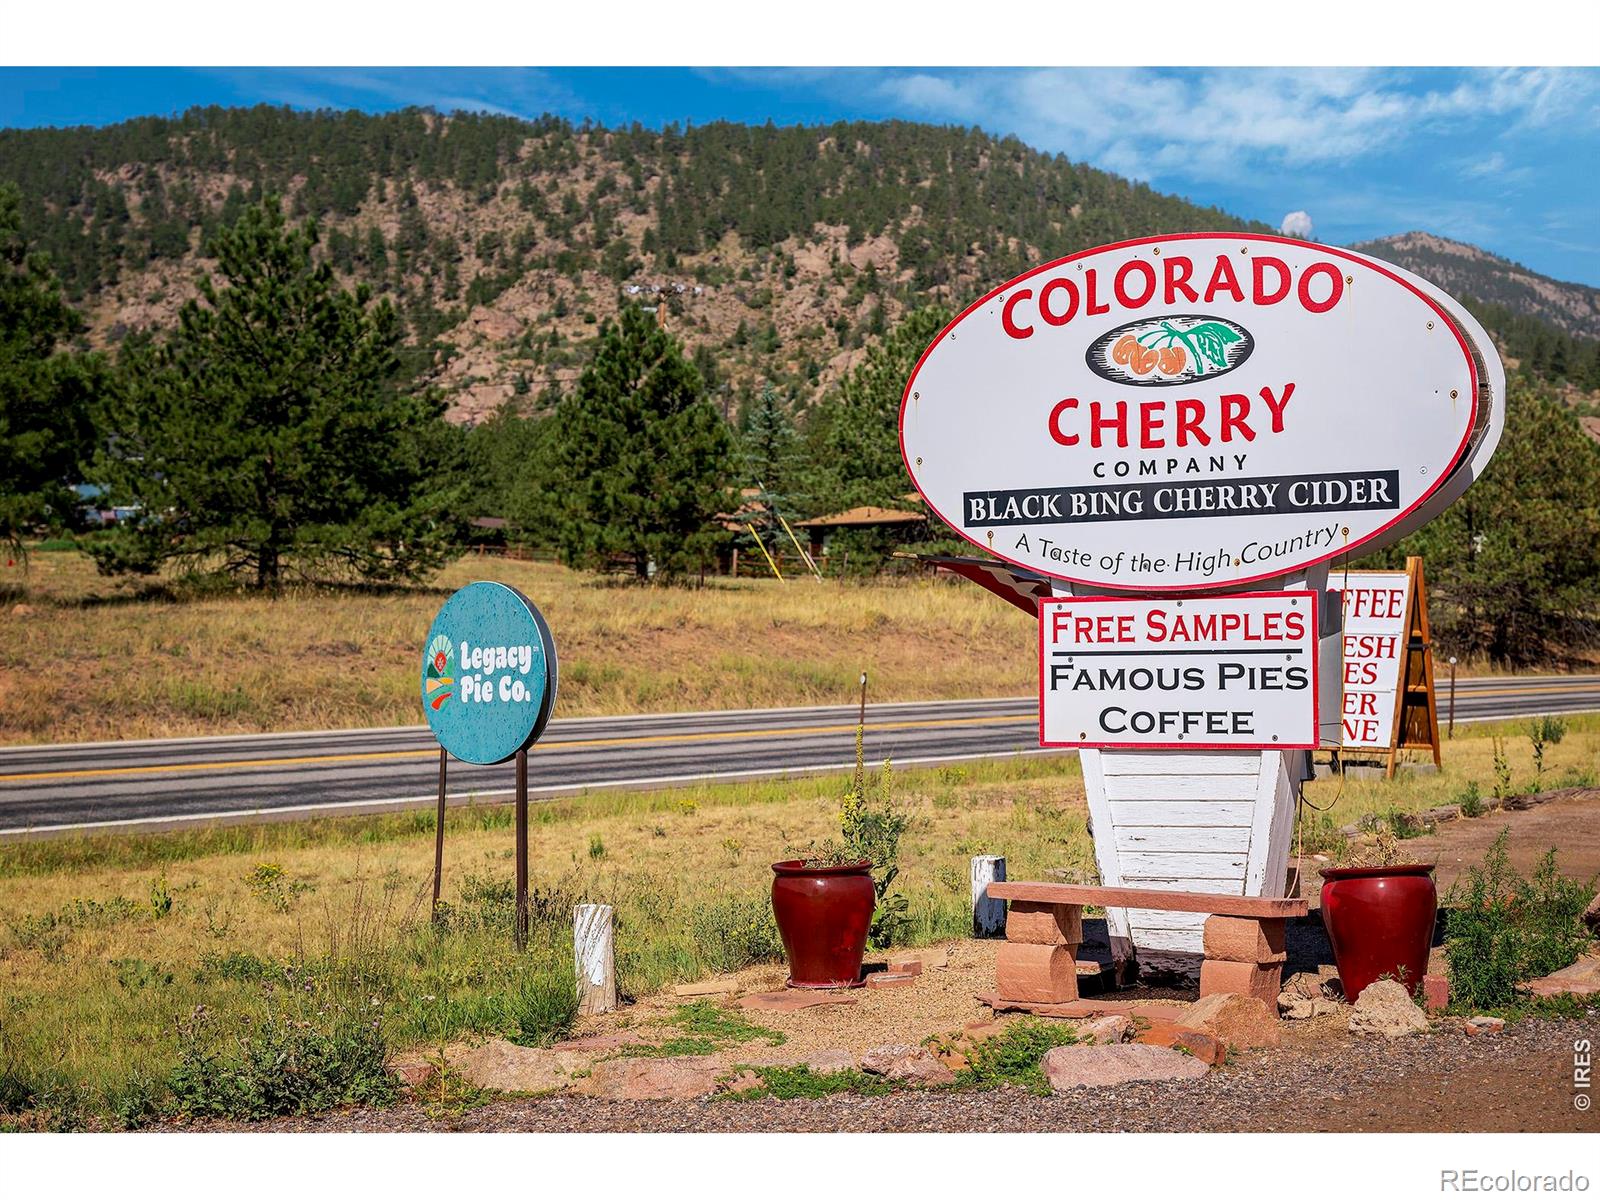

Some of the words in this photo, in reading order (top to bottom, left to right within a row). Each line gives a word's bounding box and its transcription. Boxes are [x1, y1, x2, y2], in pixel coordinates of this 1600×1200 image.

[1001, 255, 1345, 340] COLORADO
[1047, 382, 1296, 450] CHERRY
[1093, 454, 1248, 478] COMPANY
[968, 493, 1063, 521] BLACK
[1069, 489, 1144, 516] BING
[1153, 482, 1280, 513] CHERRY
[1288, 477, 1393, 507] CIDER
[1015, 532, 1031, 553] A
[1038, 538, 1092, 567] Taste
[1099, 552, 1125, 575] of
[1131, 552, 1166, 573] the
[1174, 548, 1231, 577] High
[1240, 523, 1339, 564] Country
[1339, 588, 1404, 619] FFEE
[1052, 611, 1136, 644] FREE
[1146, 609, 1305, 643] SAMPLES
[460, 641, 532, 675] Legacy
[1343, 635, 1397, 659] ESH
[1050, 663, 1206, 691] FAMOUS
[1218, 663, 1309, 691] PIES
[1343, 662, 1378, 685] ES
[460, 674, 493, 703] Pie
[498, 675, 531, 702] Co.
[1343, 692, 1379, 716] ER
[1098, 706, 1255, 734] COFFEE
[1343, 719, 1379, 742] NE
